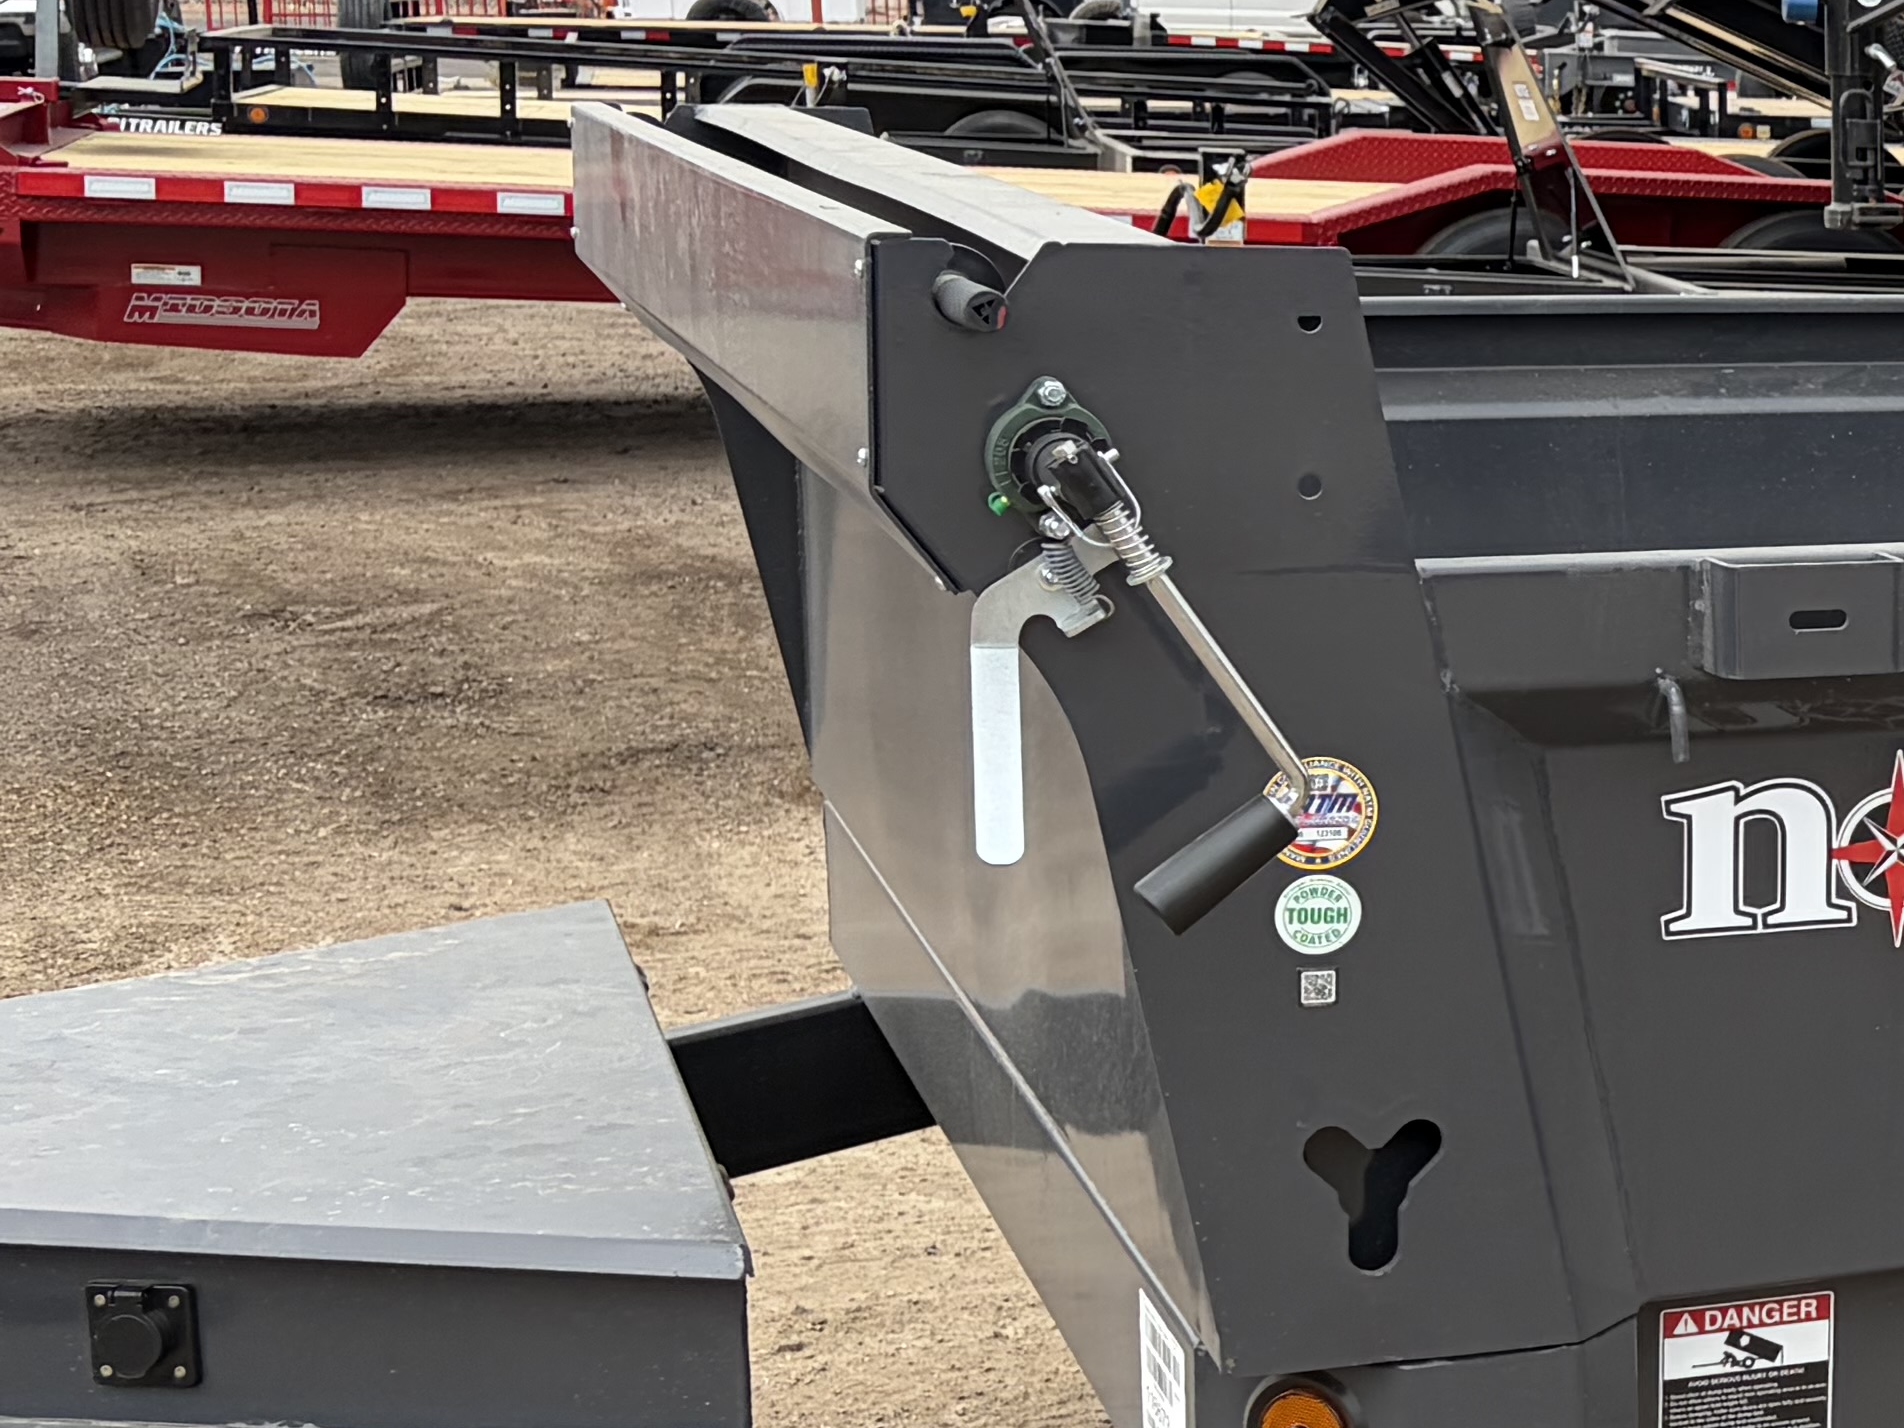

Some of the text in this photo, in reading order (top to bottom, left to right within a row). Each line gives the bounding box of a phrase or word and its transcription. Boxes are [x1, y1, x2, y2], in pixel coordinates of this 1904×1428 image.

[124, 292, 320, 329] MIDSOTA
[1293, 886, 1343, 904] POWDER
[1286, 907, 1349, 925] TOUGH
[1292, 929, 1342, 945] COATED
[1704, 1298, 1818, 1331] DANGER
